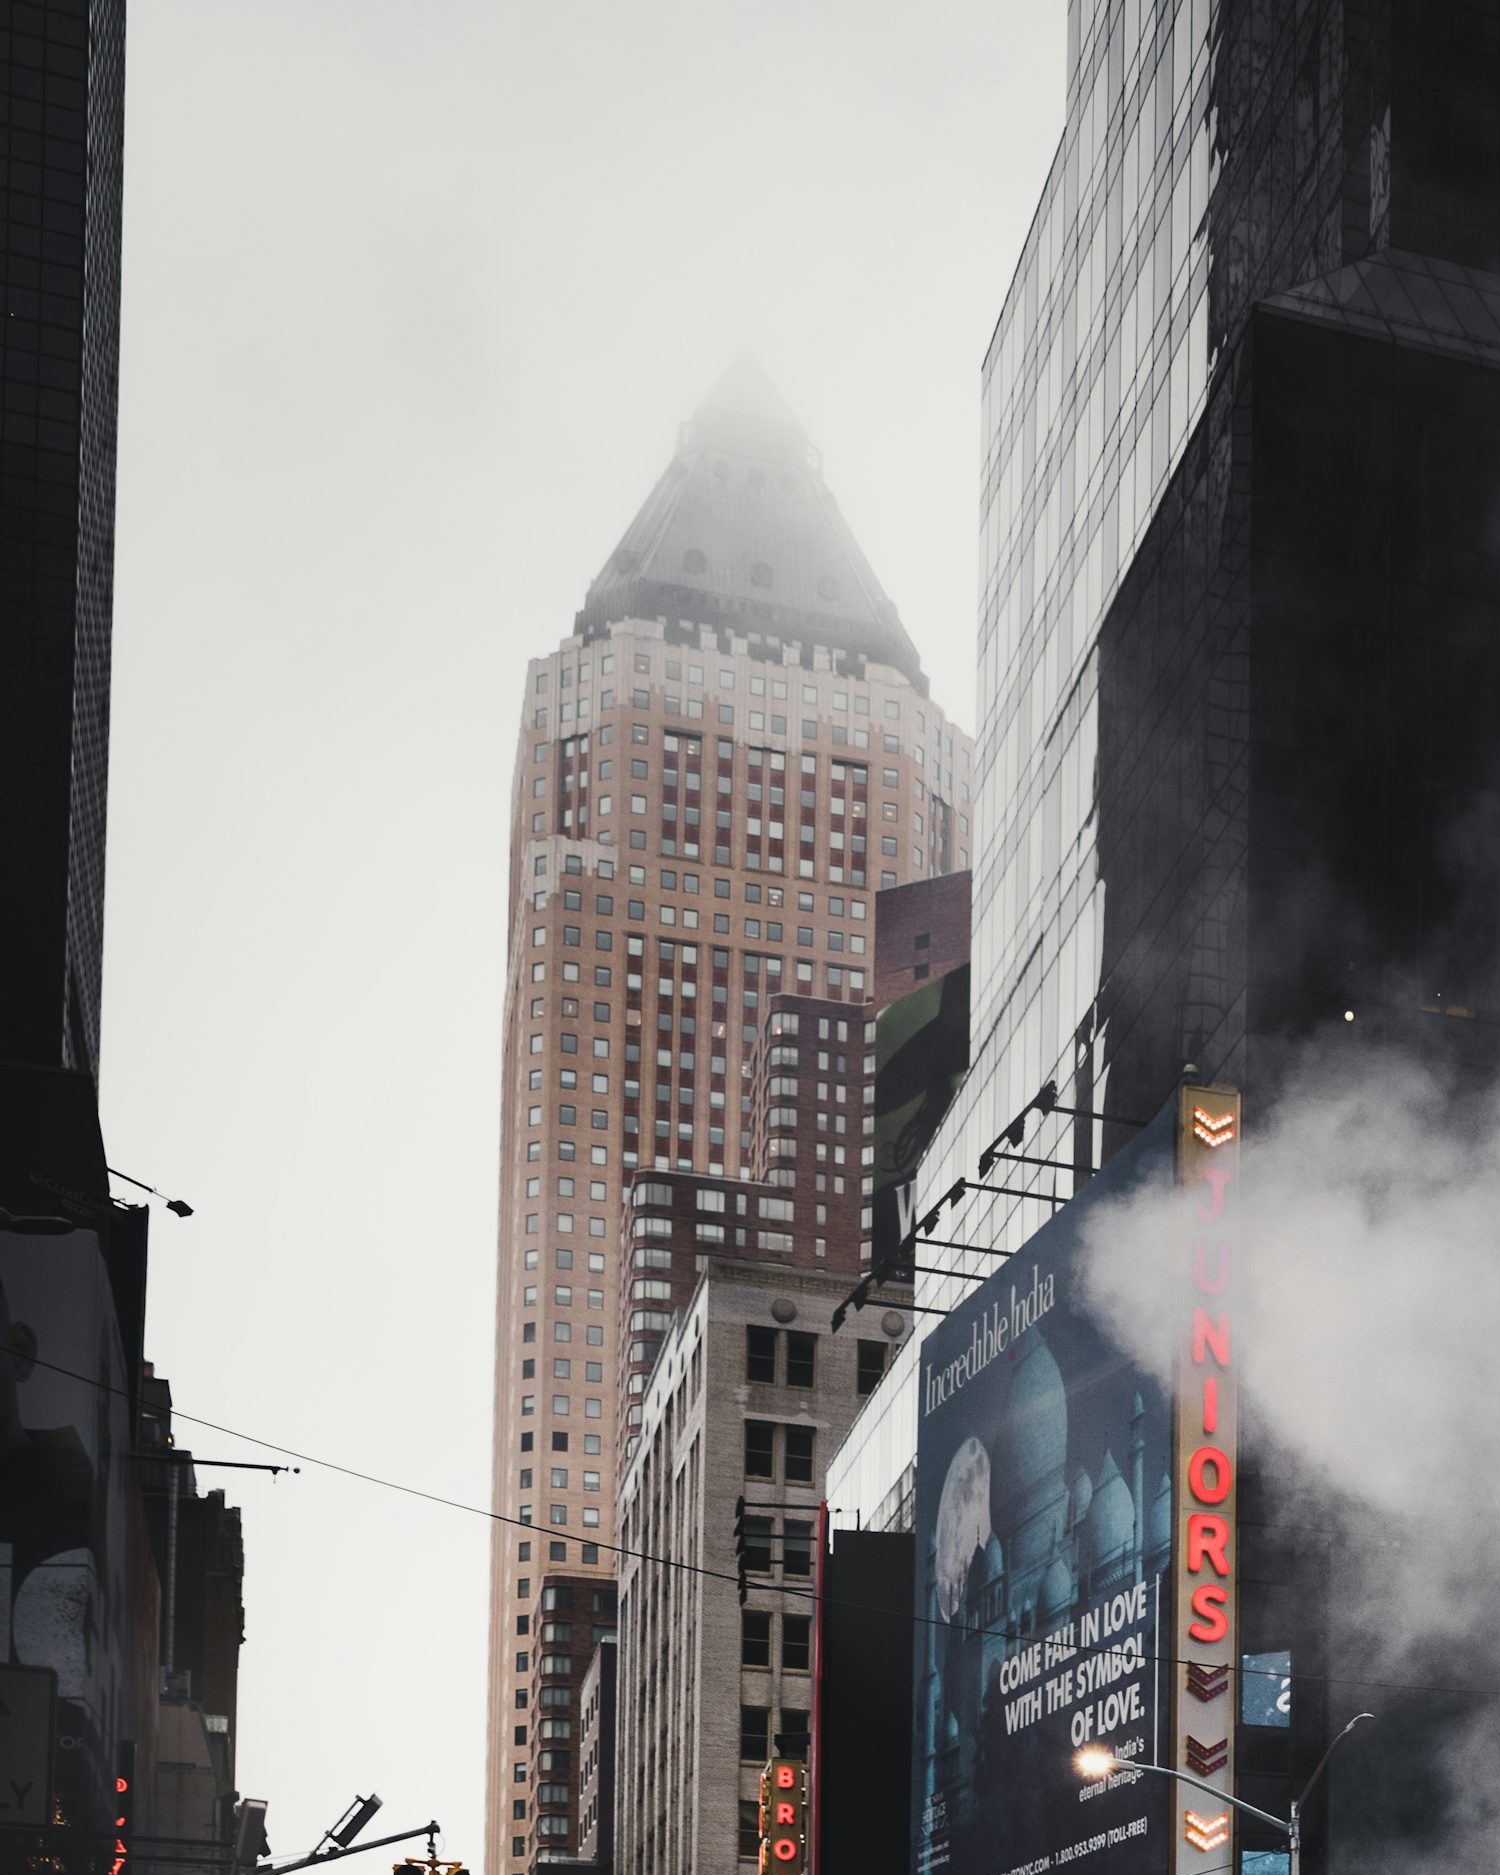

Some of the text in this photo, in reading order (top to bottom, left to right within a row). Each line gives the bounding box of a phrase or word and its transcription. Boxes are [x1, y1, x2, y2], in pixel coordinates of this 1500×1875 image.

[924, 1302, 1008, 1417] Incredible
[1188, 1168, 1233, 1645] JUNIORS
[1000, 1581, 1147, 1695] COME FALL IN LOVE
[1005, 1632, 1146, 1735] WITH THE SYMBOL
[1071, 1682, 1145, 1747] OF LOVE.
[1079, 1776, 1107, 1802] eternal
[1115, 1736, 1145, 1760] India's
[1107, 1816, 1148, 1848] (TOLL-FREE)
